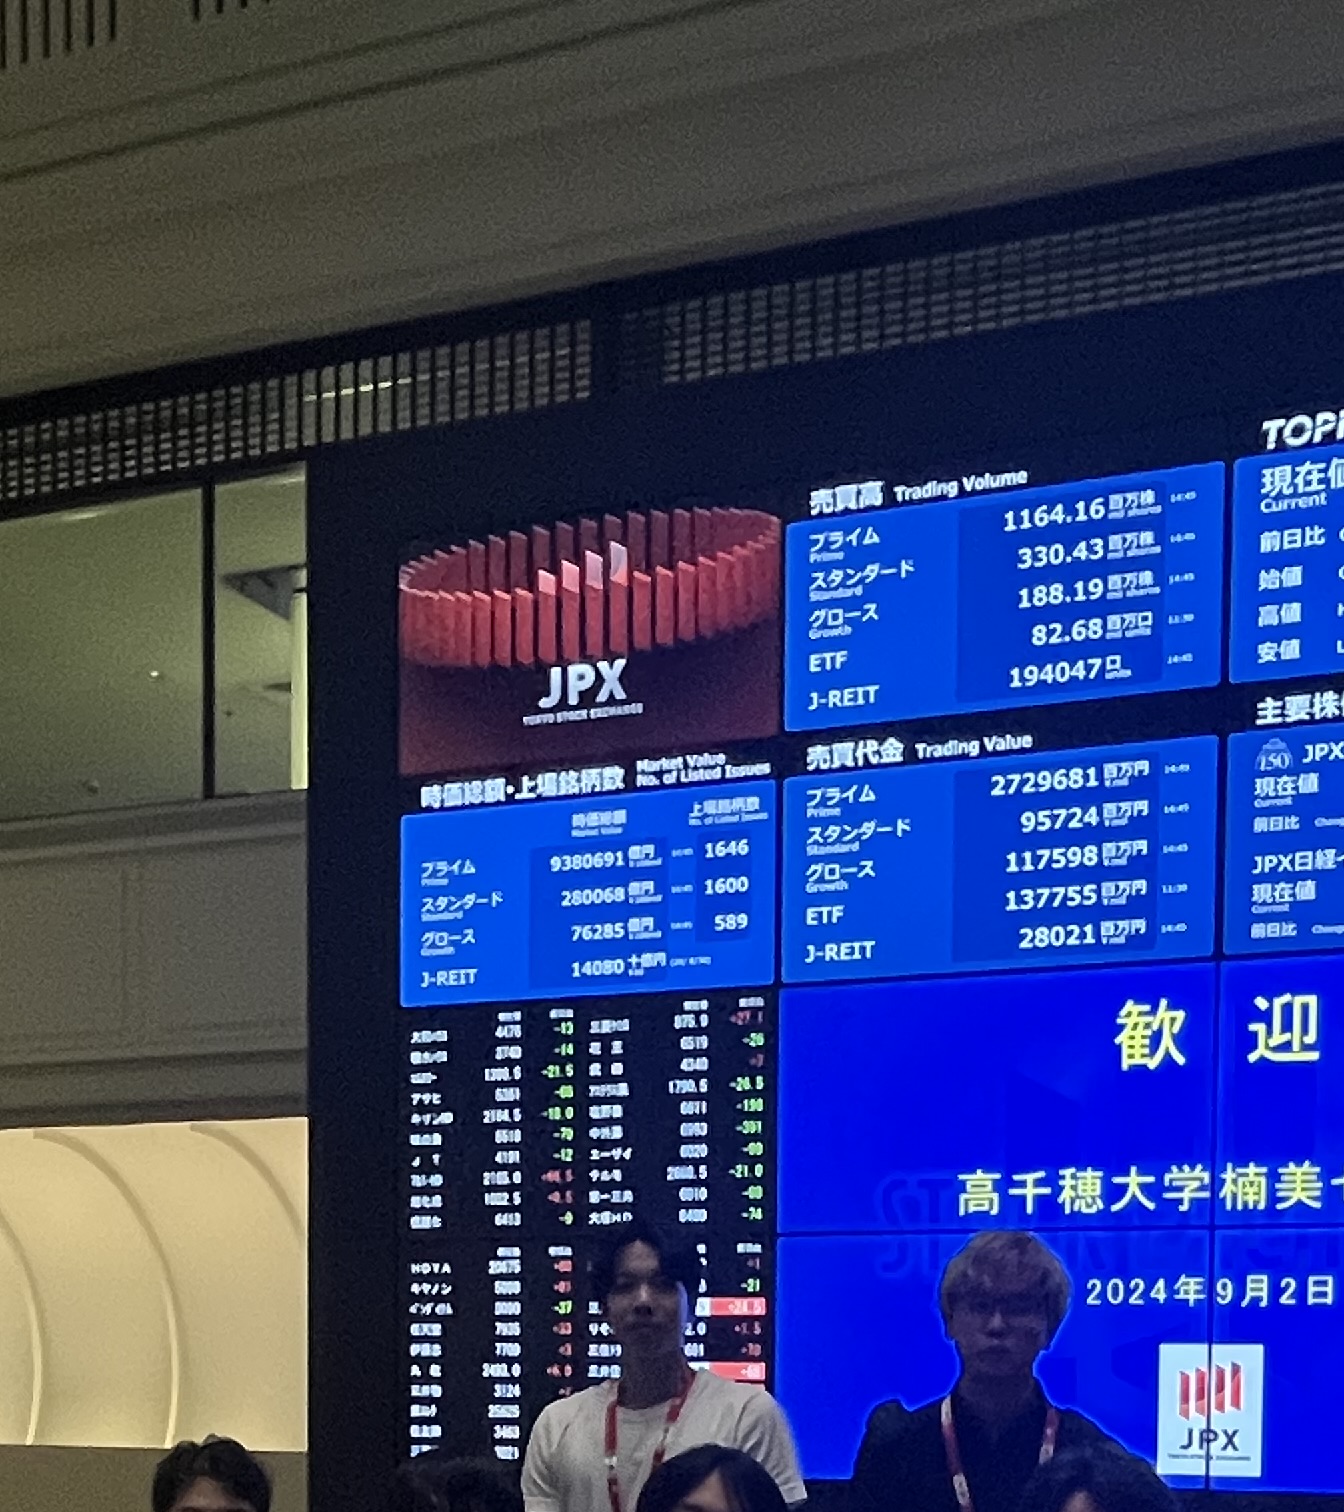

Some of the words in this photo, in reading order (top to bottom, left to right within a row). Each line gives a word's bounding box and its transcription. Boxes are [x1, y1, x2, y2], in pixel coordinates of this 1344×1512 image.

[809, 481, 884, 515] 売買高
[893, 482, 957, 503] Trading
[962, 470, 1028, 492] Volume
[1261, 492, 1327, 513] Current
[1004, 499, 1105, 531] 1164.16
[809, 527, 880, 551] プライム
[1260, 526, 1325, 552] 前日比
[1017, 538, 1104, 569] 330.43
[809, 560, 914, 590] スタンダード
[1259, 566, 1303, 591] 始値
[1019, 578, 1104, 608] 188.19
[809, 603, 879, 628] グロース
[1031, 619, 1103, 646] 82.68
[809, 651, 848, 672] ETF
[1010, 658, 1102, 688] 194047
[538, 659, 627, 708] JPX
[809, 685, 879, 710] J-REIT
[637, 756, 683, 773] Market
[688, 753, 726, 767] Value
[807, 738, 904, 771] 売買代金
[915, 739, 979, 760] Trading
[984, 733, 1033, 752] Value
[665, 772, 677, 783] of
[681, 766, 721, 783] Listed
[725, 763, 771, 777] Issues
[991, 767, 1098, 796] 2729681
[1254, 773, 1319, 796] 現在値
[807, 784, 876, 808] プライム
[808, 819, 911, 845] スタンダード
[1021, 808, 1099, 833] 95724
[1253, 815, 1299, 834] 前日比
[705, 839, 749, 859] 1646
[1006, 846, 1098, 873] 117598
[421, 859, 475, 878] プライム
[550, 851, 624, 872] 9380691
[807, 861, 875, 882] グロース
[561, 885, 625, 907] 280068
[705, 876, 748, 895] 1600
[1252, 881, 1316, 904] 現在値
[421, 891, 503, 912] スタンダード
[1005, 885, 1097, 912] 137755
[715, 913, 748, 931] 589
[806, 906, 844, 926] ETF
[421, 929, 475, 946] グロース
[572, 922, 624, 941] 76285
[1019, 924, 1095, 950] 28021
[805, 941, 875, 964] J-REIT
[421, 969, 477, 988] J-REIT
[572, 958, 624, 977] 14080
[1086, 1273, 1336, 1307] 2024年9月2日
[1179, 1428, 1239, 1451] JPX
